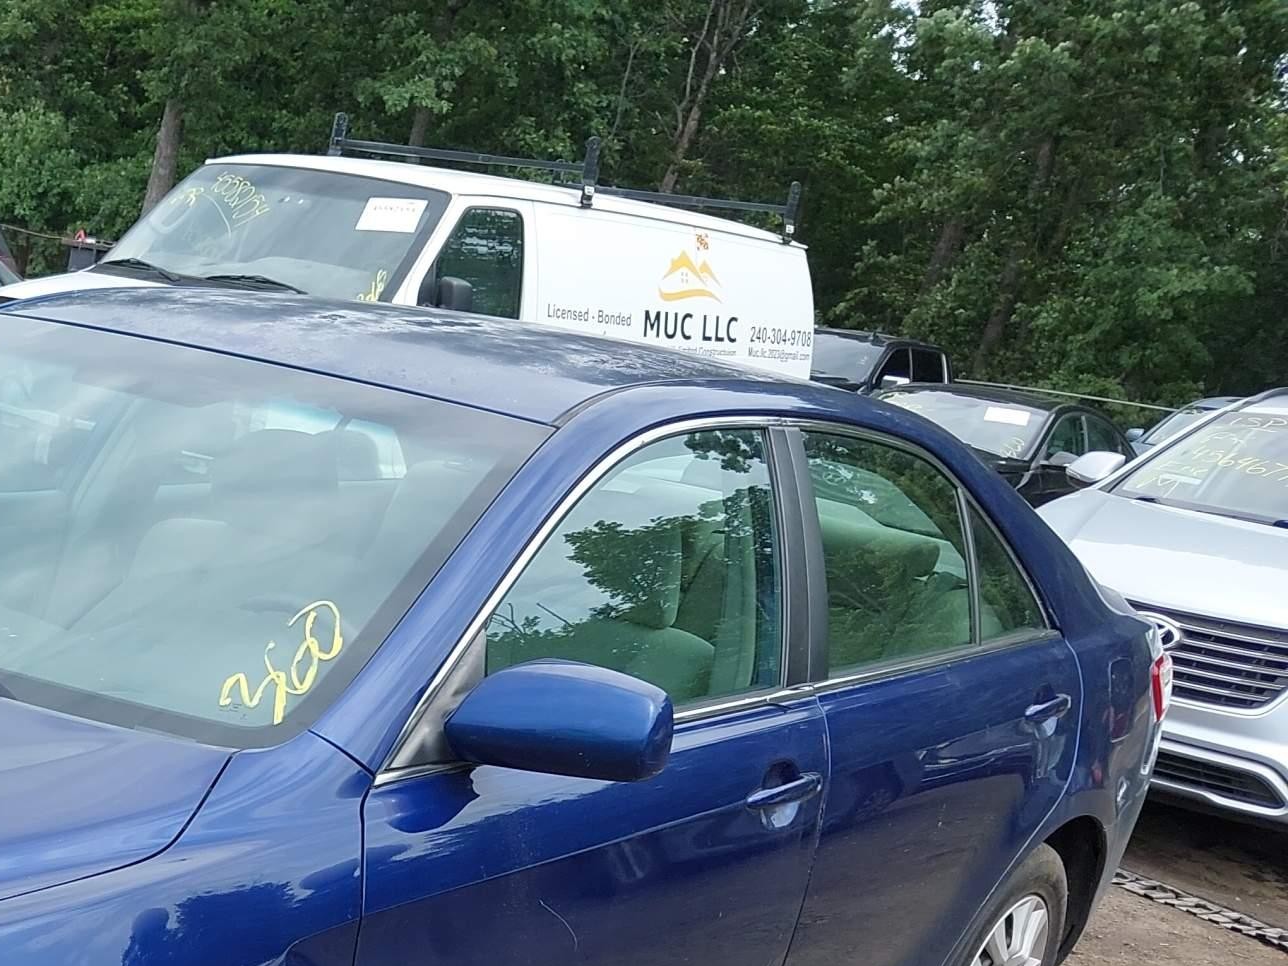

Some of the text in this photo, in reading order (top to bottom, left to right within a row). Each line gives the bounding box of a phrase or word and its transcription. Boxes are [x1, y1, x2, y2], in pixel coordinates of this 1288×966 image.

[547, 303, 589, 321] Licensed
[597, 309, 632, 326] Bonded
[643, 309, 738, 343] MUC LLC
[750, 326, 812, 347] 240-304-9708
